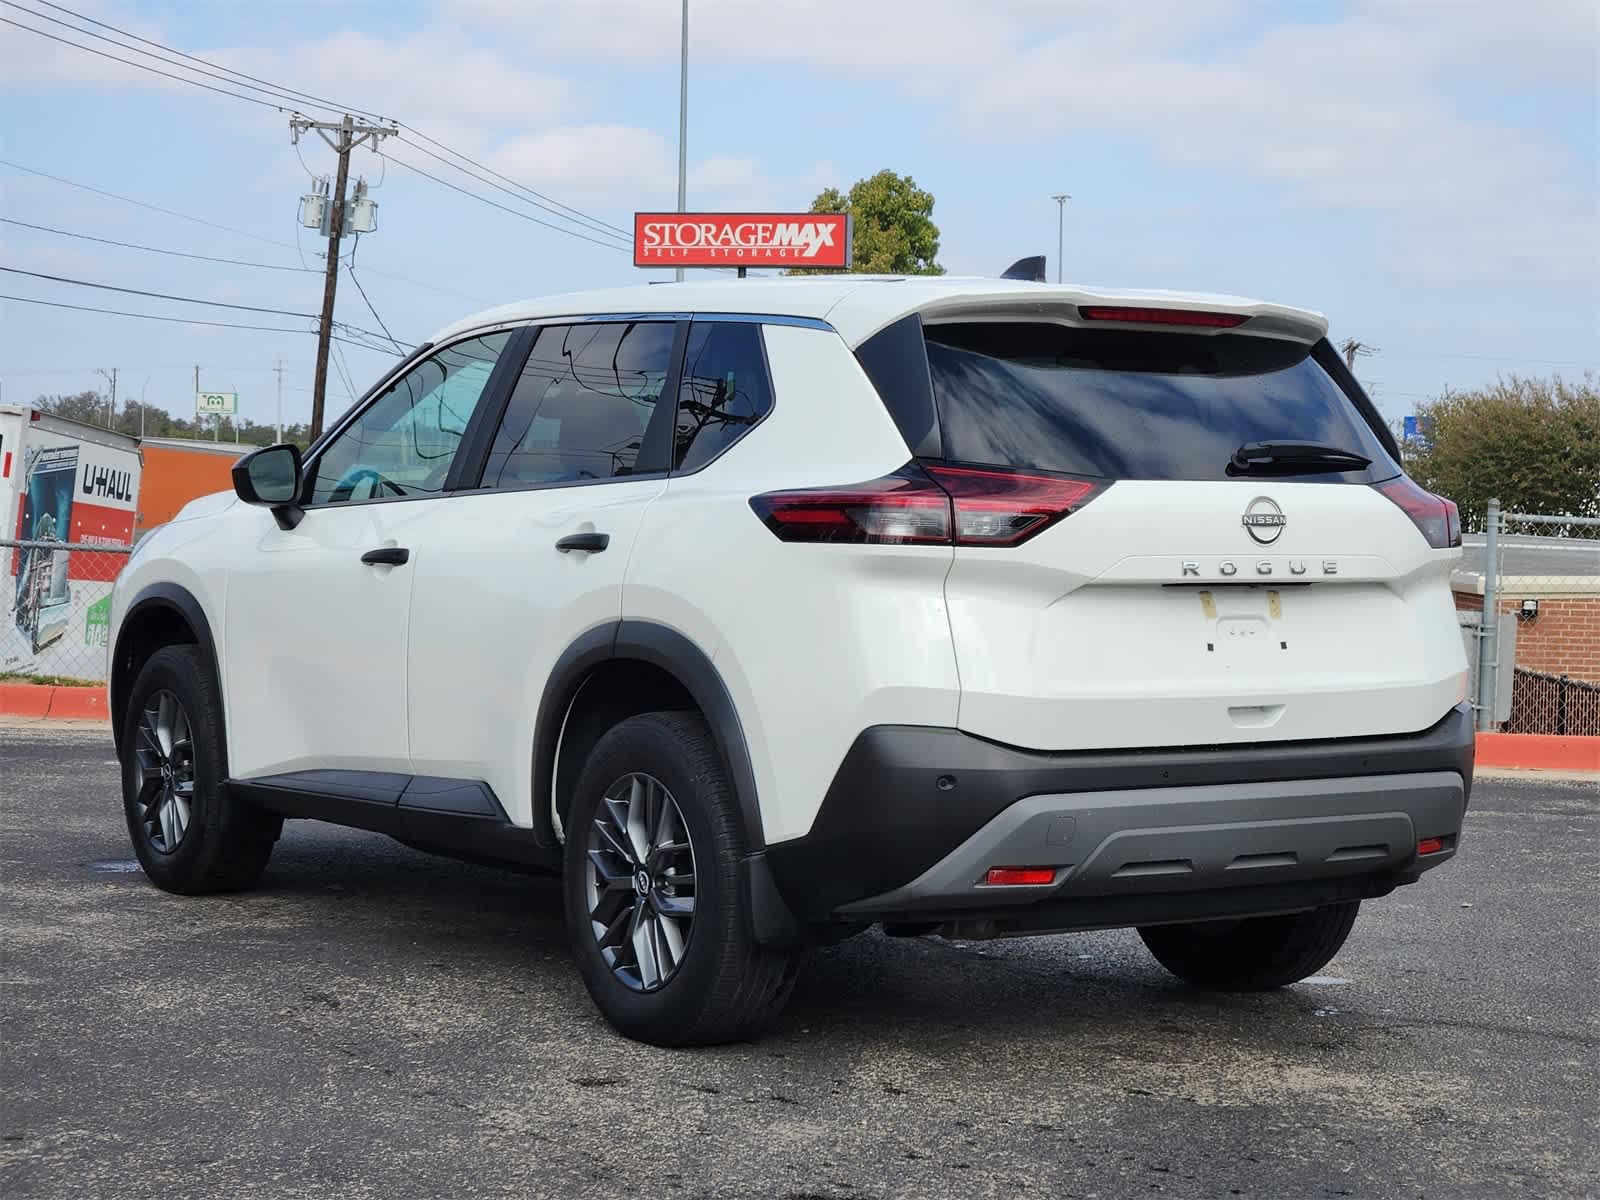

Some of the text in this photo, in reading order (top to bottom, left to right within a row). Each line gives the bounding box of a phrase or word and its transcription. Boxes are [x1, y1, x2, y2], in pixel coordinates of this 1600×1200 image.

[643, 223, 837, 256] STORAGEMAX
[643, 248, 801, 257] SELF STORAGE
[83, 464, 132, 502] U-HAUL
[1243, 515, 1287, 525] NISSAN
[1182, 560, 1338, 576] ROGUE
